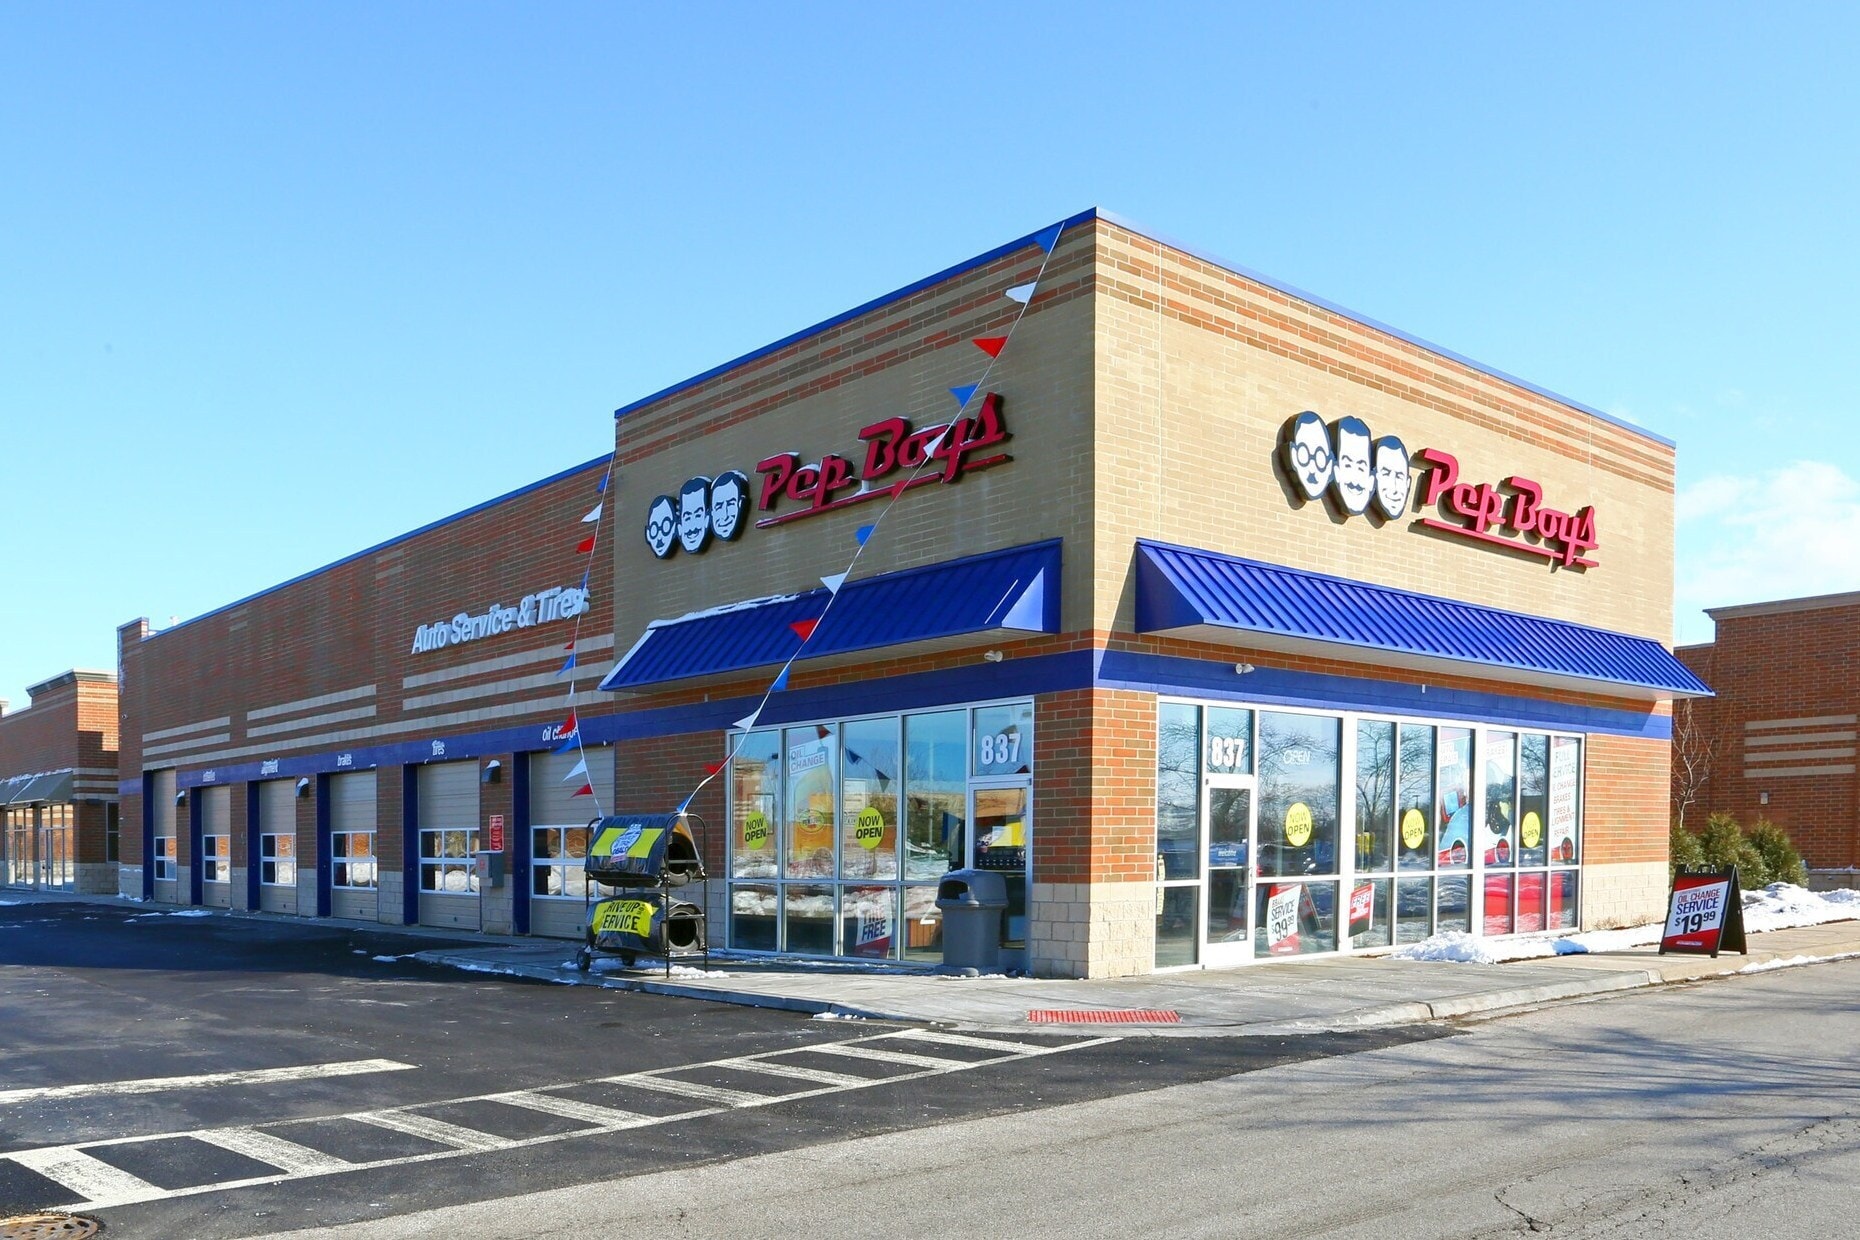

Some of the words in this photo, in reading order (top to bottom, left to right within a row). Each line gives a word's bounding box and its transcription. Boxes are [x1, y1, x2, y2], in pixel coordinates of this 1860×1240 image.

[755, 452, 858, 511] Pep
[858, 392, 1005, 484] Boys
[1418, 448, 1506, 533] Pep
[1509, 476, 1599, 566] Boys
[411, 622, 451, 654] Auto
[450, 604, 517, 645] Service
[517, 595, 537, 628] &
[791, 748, 802, 760] OIL
[981, 732, 1021, 765] 837
[1210, 736, 1245, 768] 837
[791, 755, 824, 772] CHANGE
[1283, 749, 1311, 765] OPEN
[1553, 763, 1575, 778] ERVICE
[745, 817, 764, 831] NOW
[858, 815, 880, 827] NOW
[1551, 812, 1575, 827] LIGNMENT
[744, 827, 767, 842] OPEN
[856, 827, 882, 839] OPEN
[1287, 823, 1310, 836] OPEN
[1404, 827, 1423, 840] OPEN
[1678, 895, 1688, 904] OIL
[1690, 888, 1721, 900] CHANGE
[604, 902, 627, 913] RIVE
[625, 902, 640, 912] UP
[1271, 899, 1295, 921] SERVICE
[1676, 897, 1720, 915] SERVICE
[603, 915, 640, 930] ERVICE
[862, 919, 886, 941] FREE
